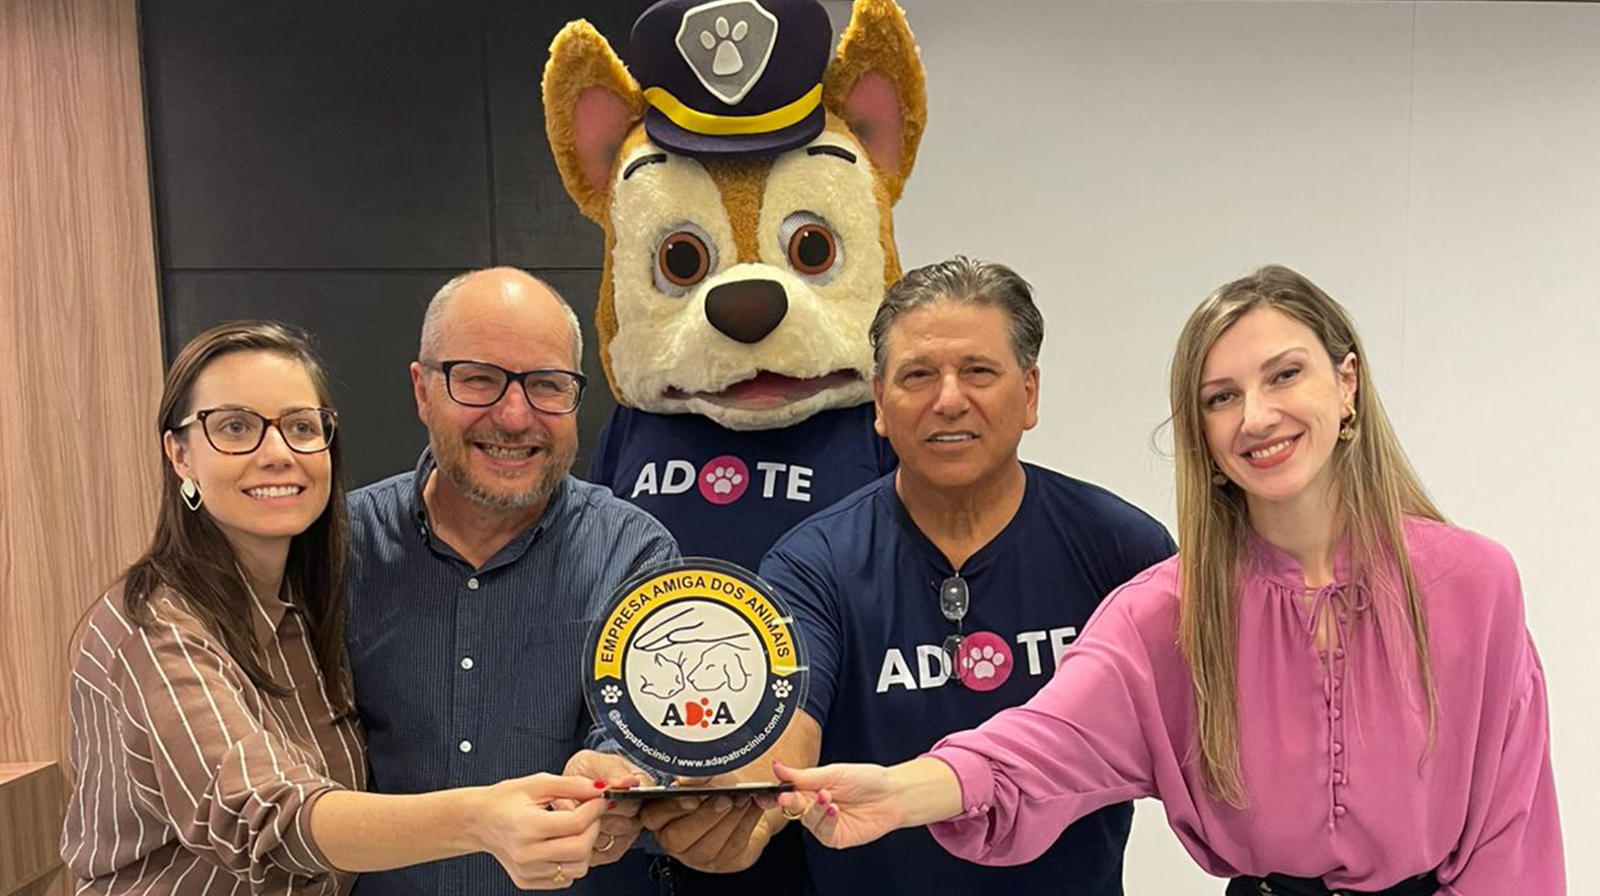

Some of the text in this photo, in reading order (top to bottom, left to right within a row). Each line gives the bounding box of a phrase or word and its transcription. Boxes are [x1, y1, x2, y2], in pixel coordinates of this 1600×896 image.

[631, 455, 813, 505] ADOTE
[601, 576, 790, 663] EMPRESA AMIGA DOS ANIMAIS
[608, 709, 671, 763] @adapatrocinio
[677, 701, 786, 767] www.adapatrocinio.com.br
[660, 697, 736, 729] ADA
